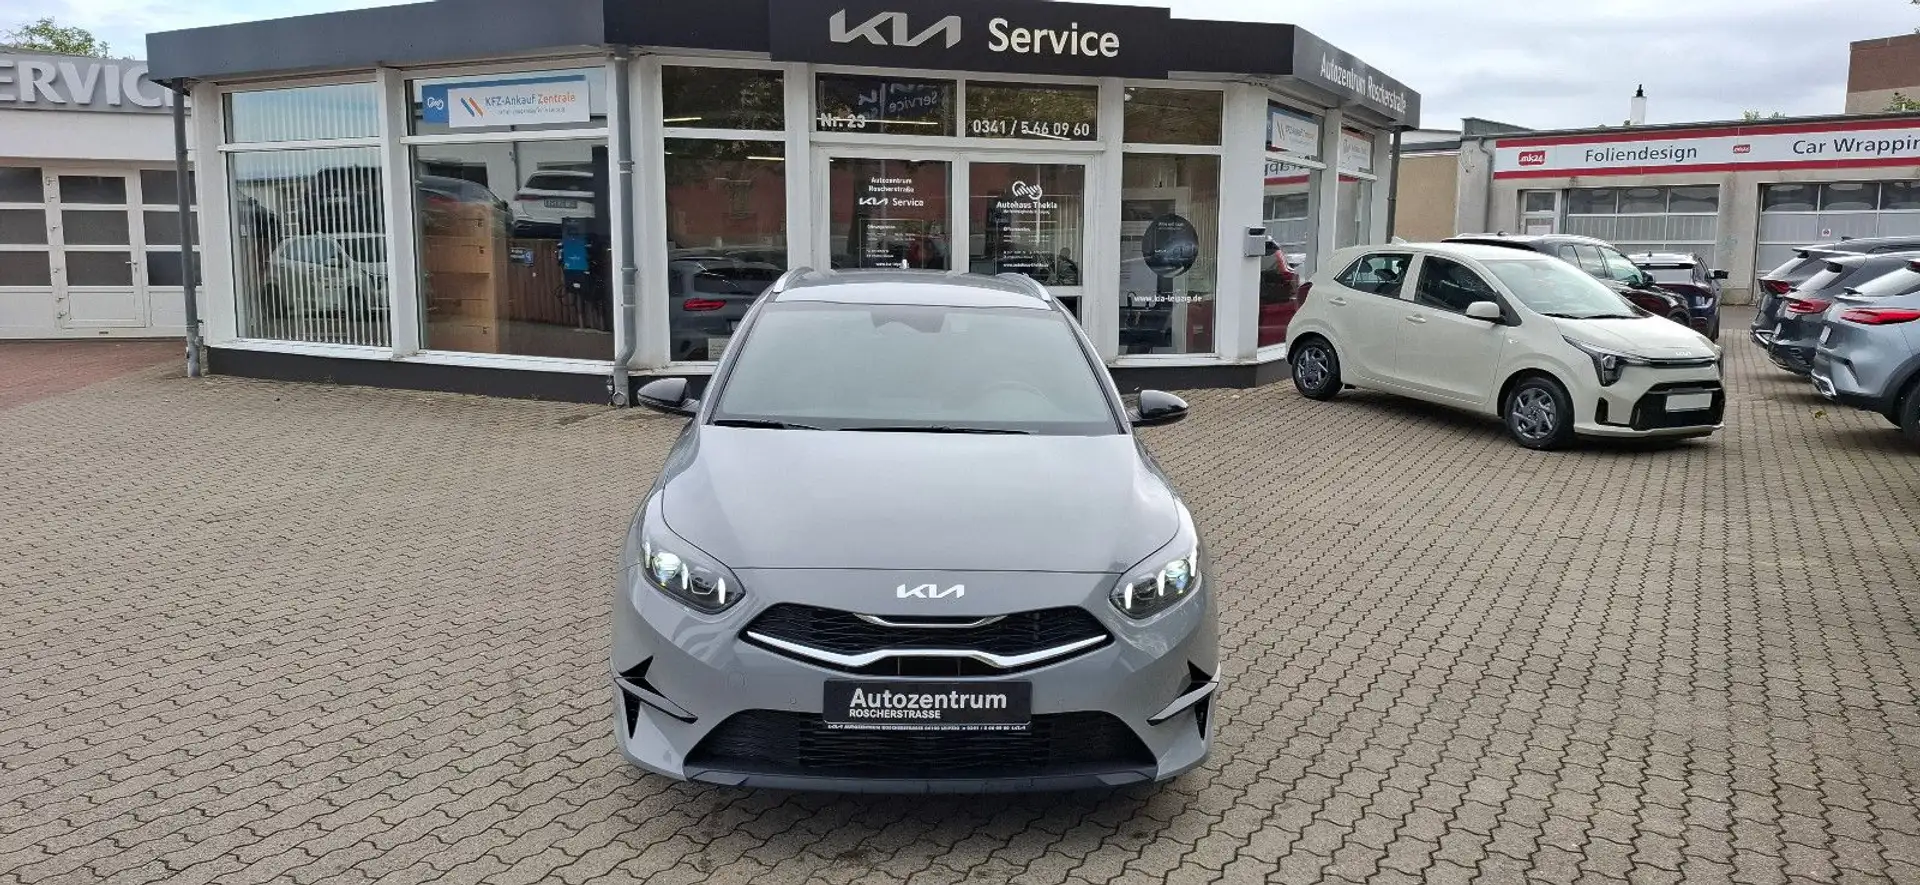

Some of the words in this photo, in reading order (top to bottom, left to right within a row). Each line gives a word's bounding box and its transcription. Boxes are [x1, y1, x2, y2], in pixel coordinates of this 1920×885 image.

[829, 8, 961, 49] KIA
[988, 17, 1120, 58] Service
[1320, 52, 1366, 96] Autozentrum
[485, 94, 536, 107] KFZ-Ankauf
[538, 92, 576, 104] Zentrale
[820, 113, 844, 128] Nr.
[847, 113, 866, 129] 23
[973, 119, 1006, 134] 0341
[1010, 120, 1017, 135] /
[1032, 122, 1049, 136] 66
[1053, 122, 1069, 136] 09
[1073, 122, 1090, 137] 60
[1585, 145, 1697, 163] Foliendesign
[1793, 140, 1826, 154] Car
[868, 185, 914, 193] Roscherstraße
[892, 198, 924, 207] Service
[996, 201, 1032, 209] Autohaus
[1134, 294, 1203, 304] www.kia-leipzig.de
[896, 584, 965, 599] KIA
[850, 688, 1007, 709] Autozentrum
[849, 709, 941, 719] ROSCHERSTRASSE
